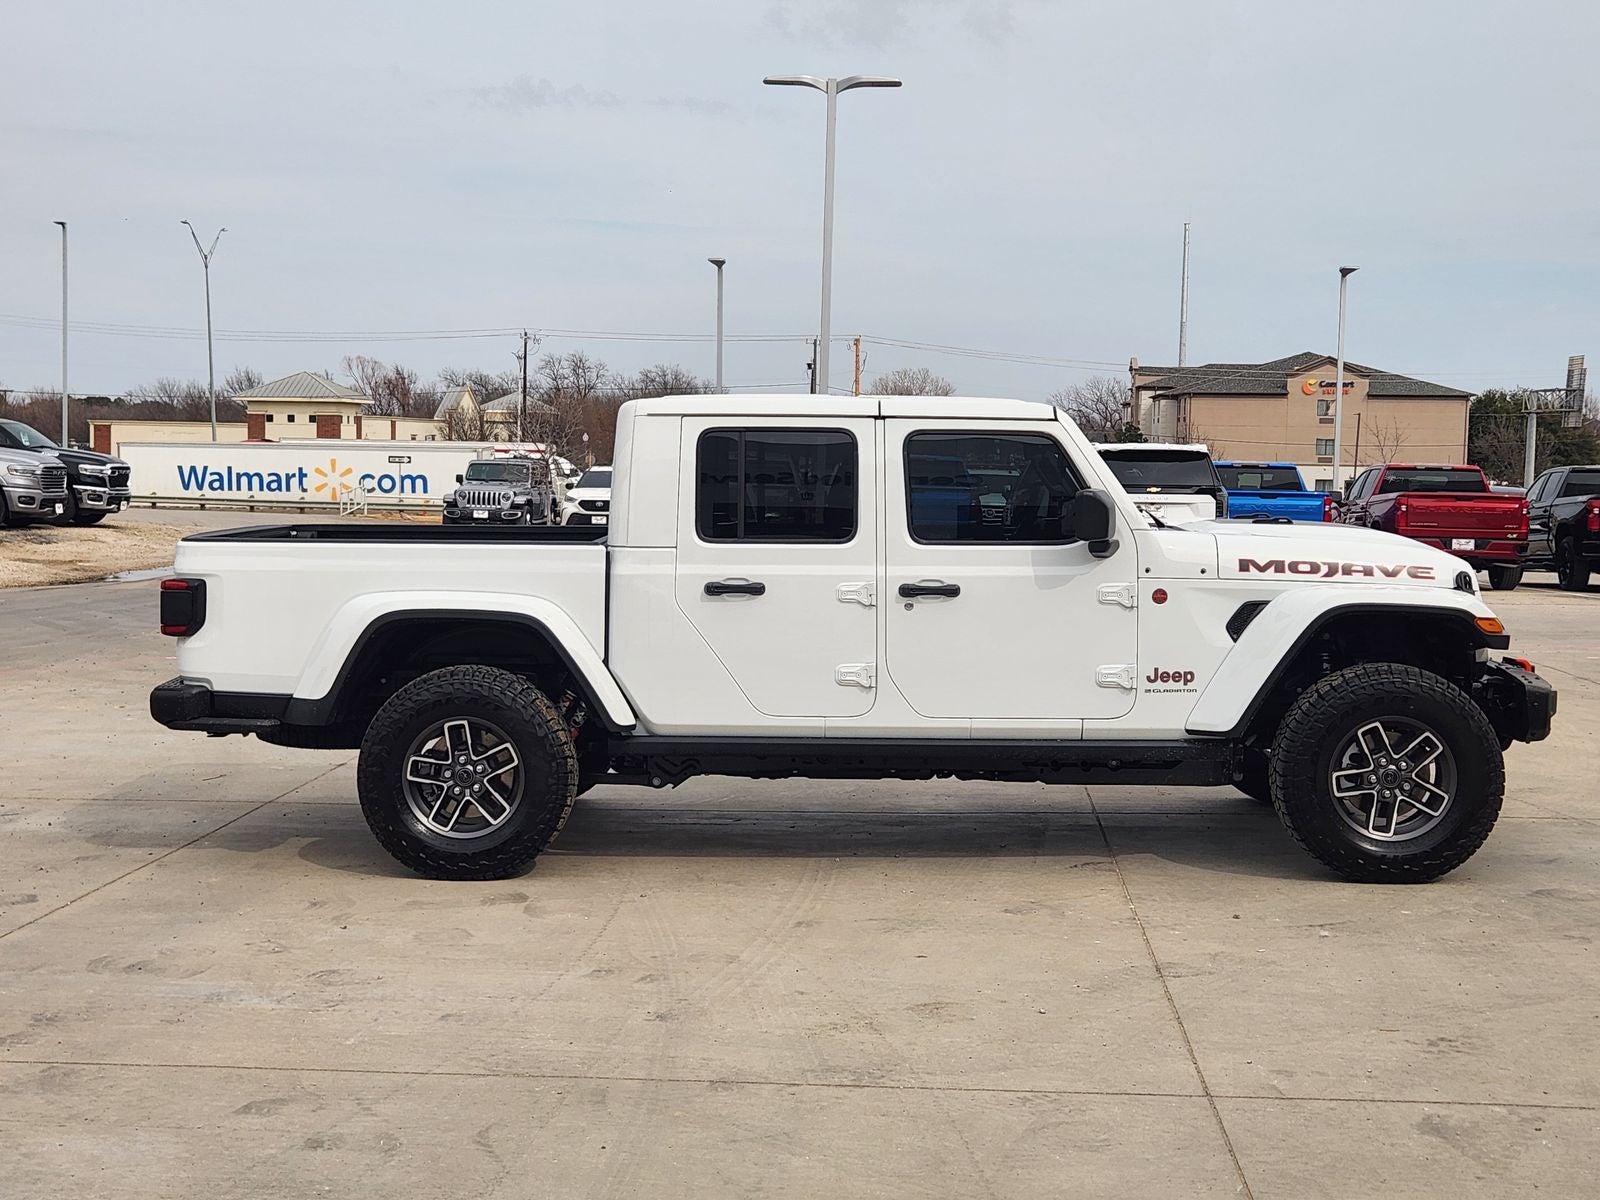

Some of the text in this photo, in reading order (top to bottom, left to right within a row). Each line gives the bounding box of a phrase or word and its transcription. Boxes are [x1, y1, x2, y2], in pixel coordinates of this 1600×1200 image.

[1319, 380, 1355, 388] Comort
[177, 465, 308, 492] Walmart
[1238, 558, 1436, 580] MOJAVE
[1146, 667, 1195, 686] Jeep
